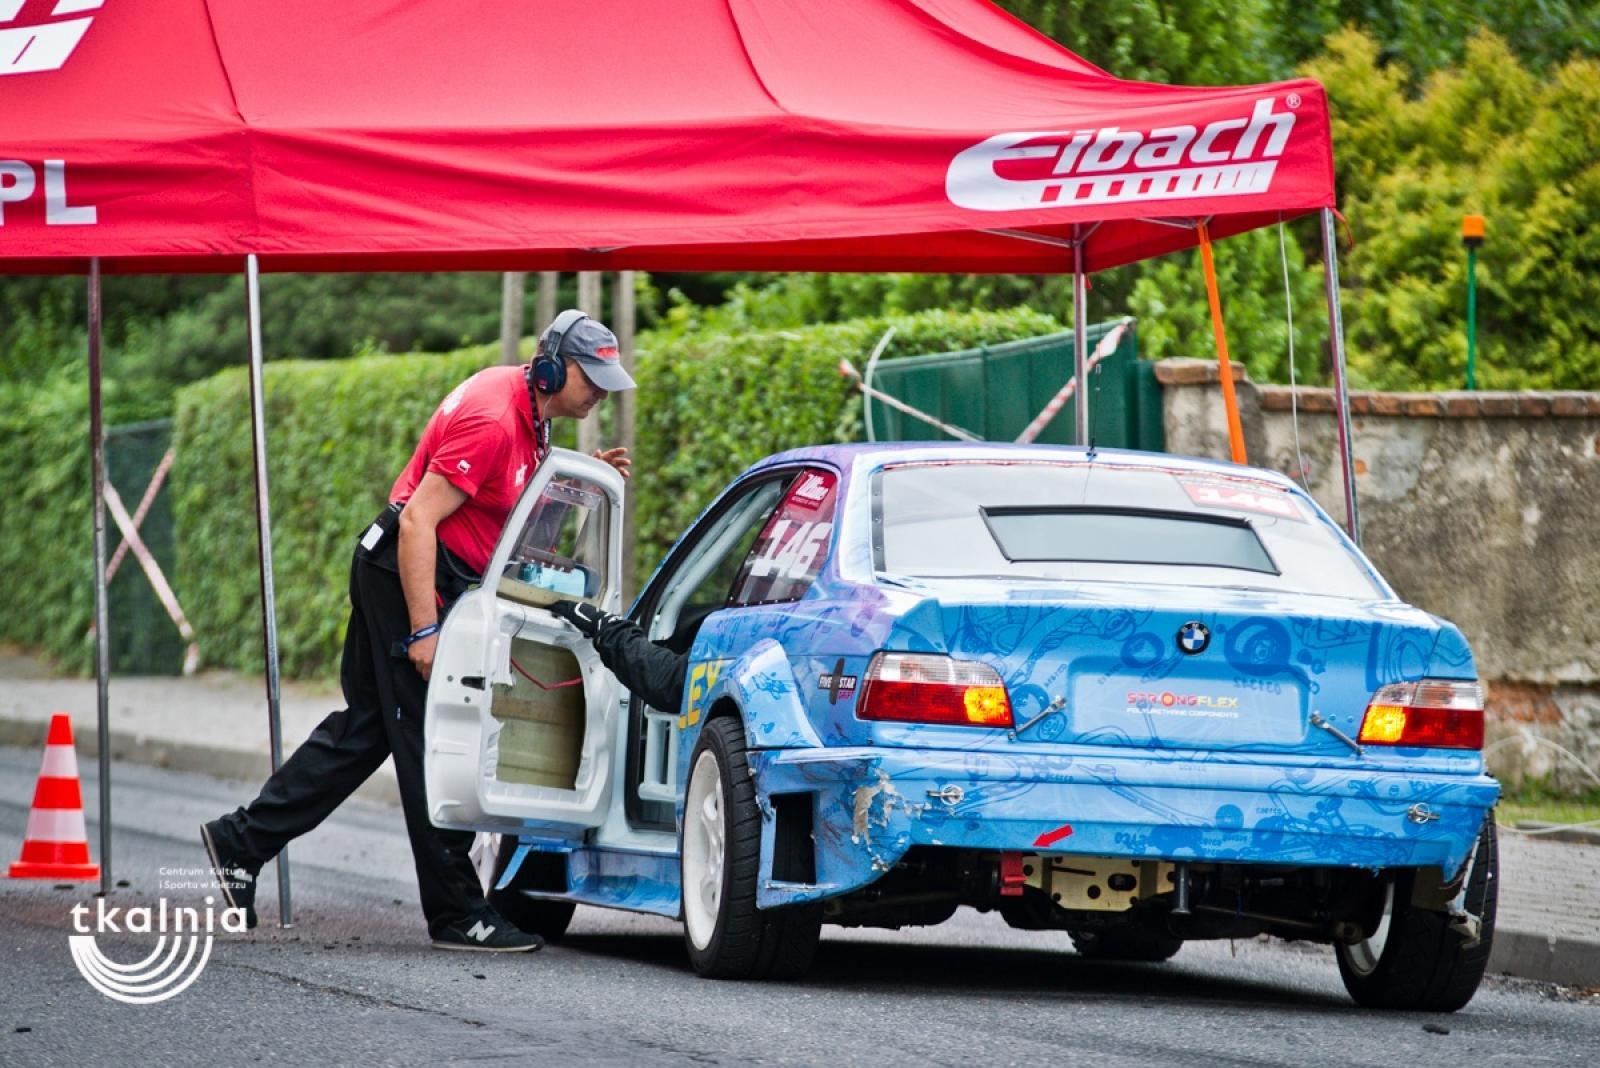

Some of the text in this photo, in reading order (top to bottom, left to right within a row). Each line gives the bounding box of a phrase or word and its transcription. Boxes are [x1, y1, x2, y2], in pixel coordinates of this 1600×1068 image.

[945, 98, 1297, 211] Eibach
[750, 519, 833, 579] 146
[818, 675, 856, 690] FIVE STAR
[1126, 691, 1239, 709] STRONGFLEX
